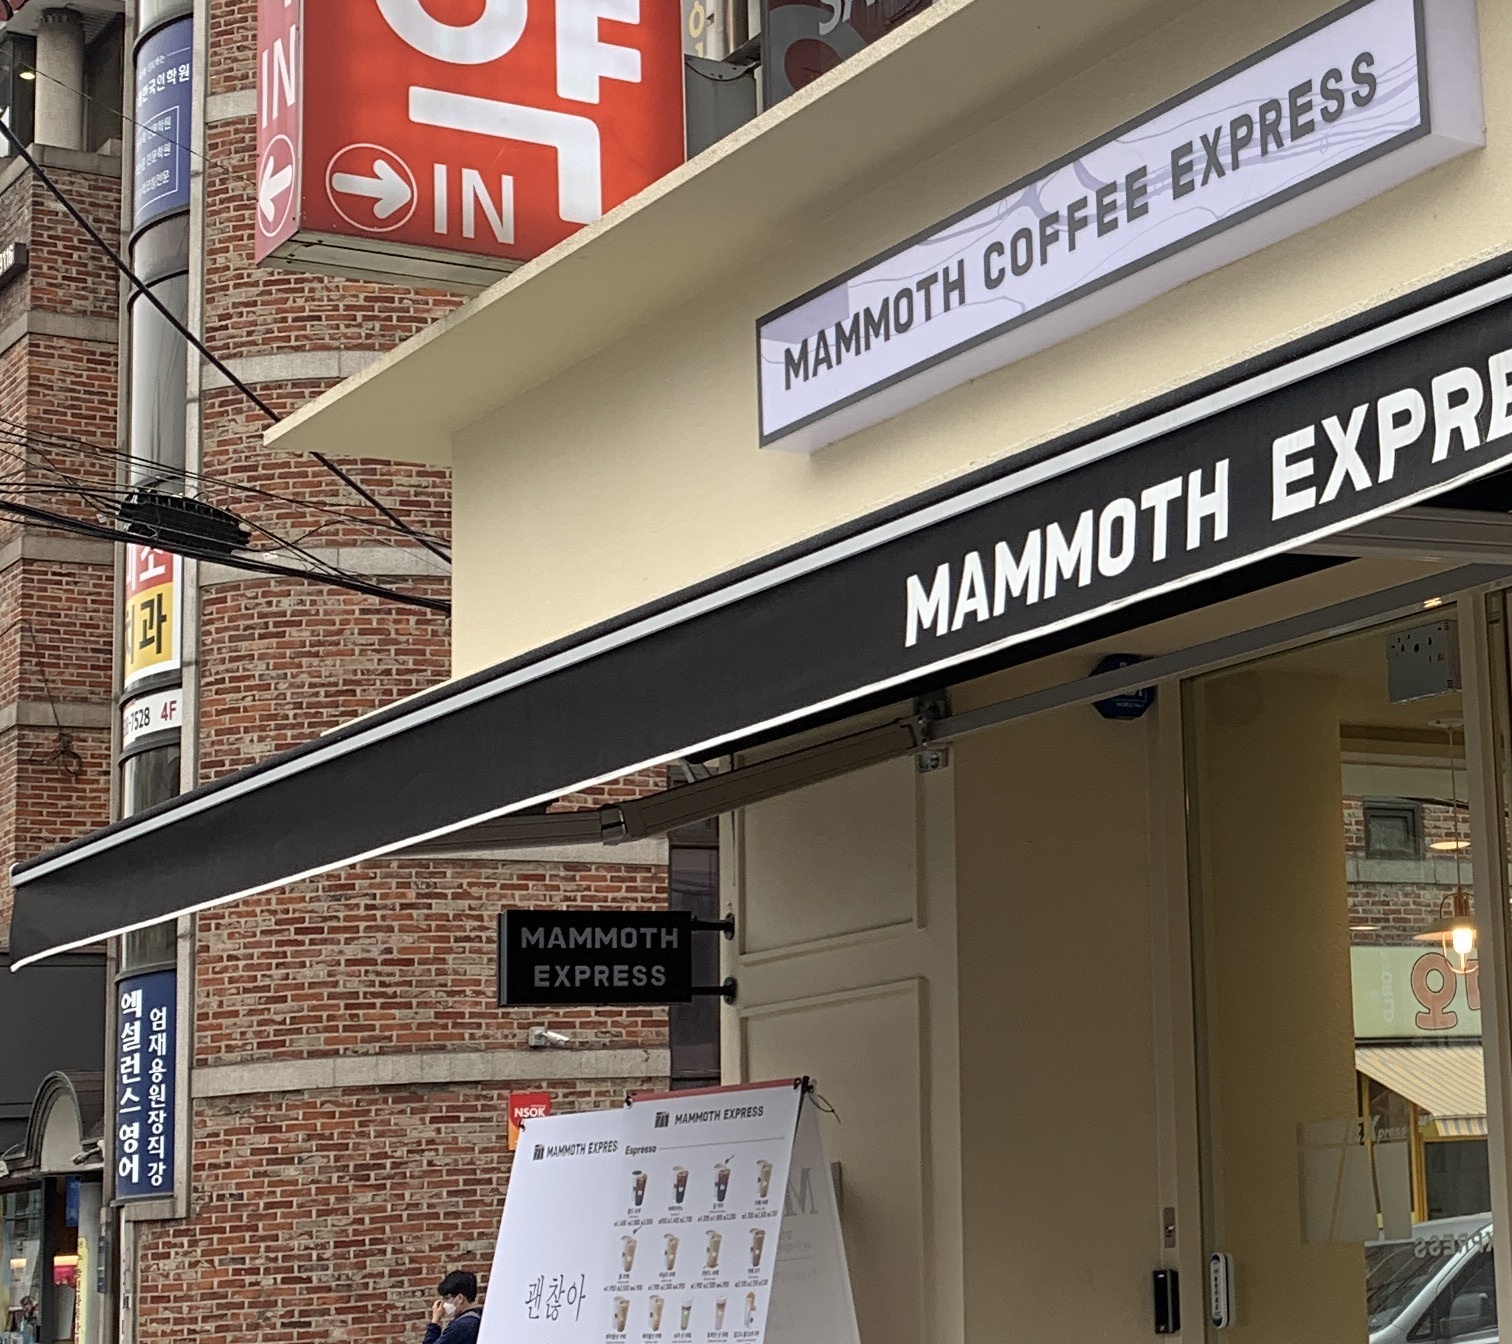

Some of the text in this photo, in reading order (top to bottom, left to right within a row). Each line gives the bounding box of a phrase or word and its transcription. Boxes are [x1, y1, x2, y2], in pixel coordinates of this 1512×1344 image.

[261, 25, 297, 129] IN
[433, 160, 516, 246] IN
[782, 49, 1378, 392] MAMMOTH COFFEE EXPRESS
[903, 458, 1229, 647] MAMMOTH
[160, 699, 178, 721] 4F
[521, 927, 679, 949] MAMMOTH
[534, 965, 666, 987] EXPRESS
[118, 989, 143, 1183] 엑설런스 영어
[513, 1106, 547, 1119] NSOK
[674, 1105, 765, 1125] MAMMOTH EXPRESS
[546, 1142, 587, 1158] MAMMOTH
[625, 1144, 657, 1157] Espresso
[525, 1273, 586, 1321] 괜찮아
